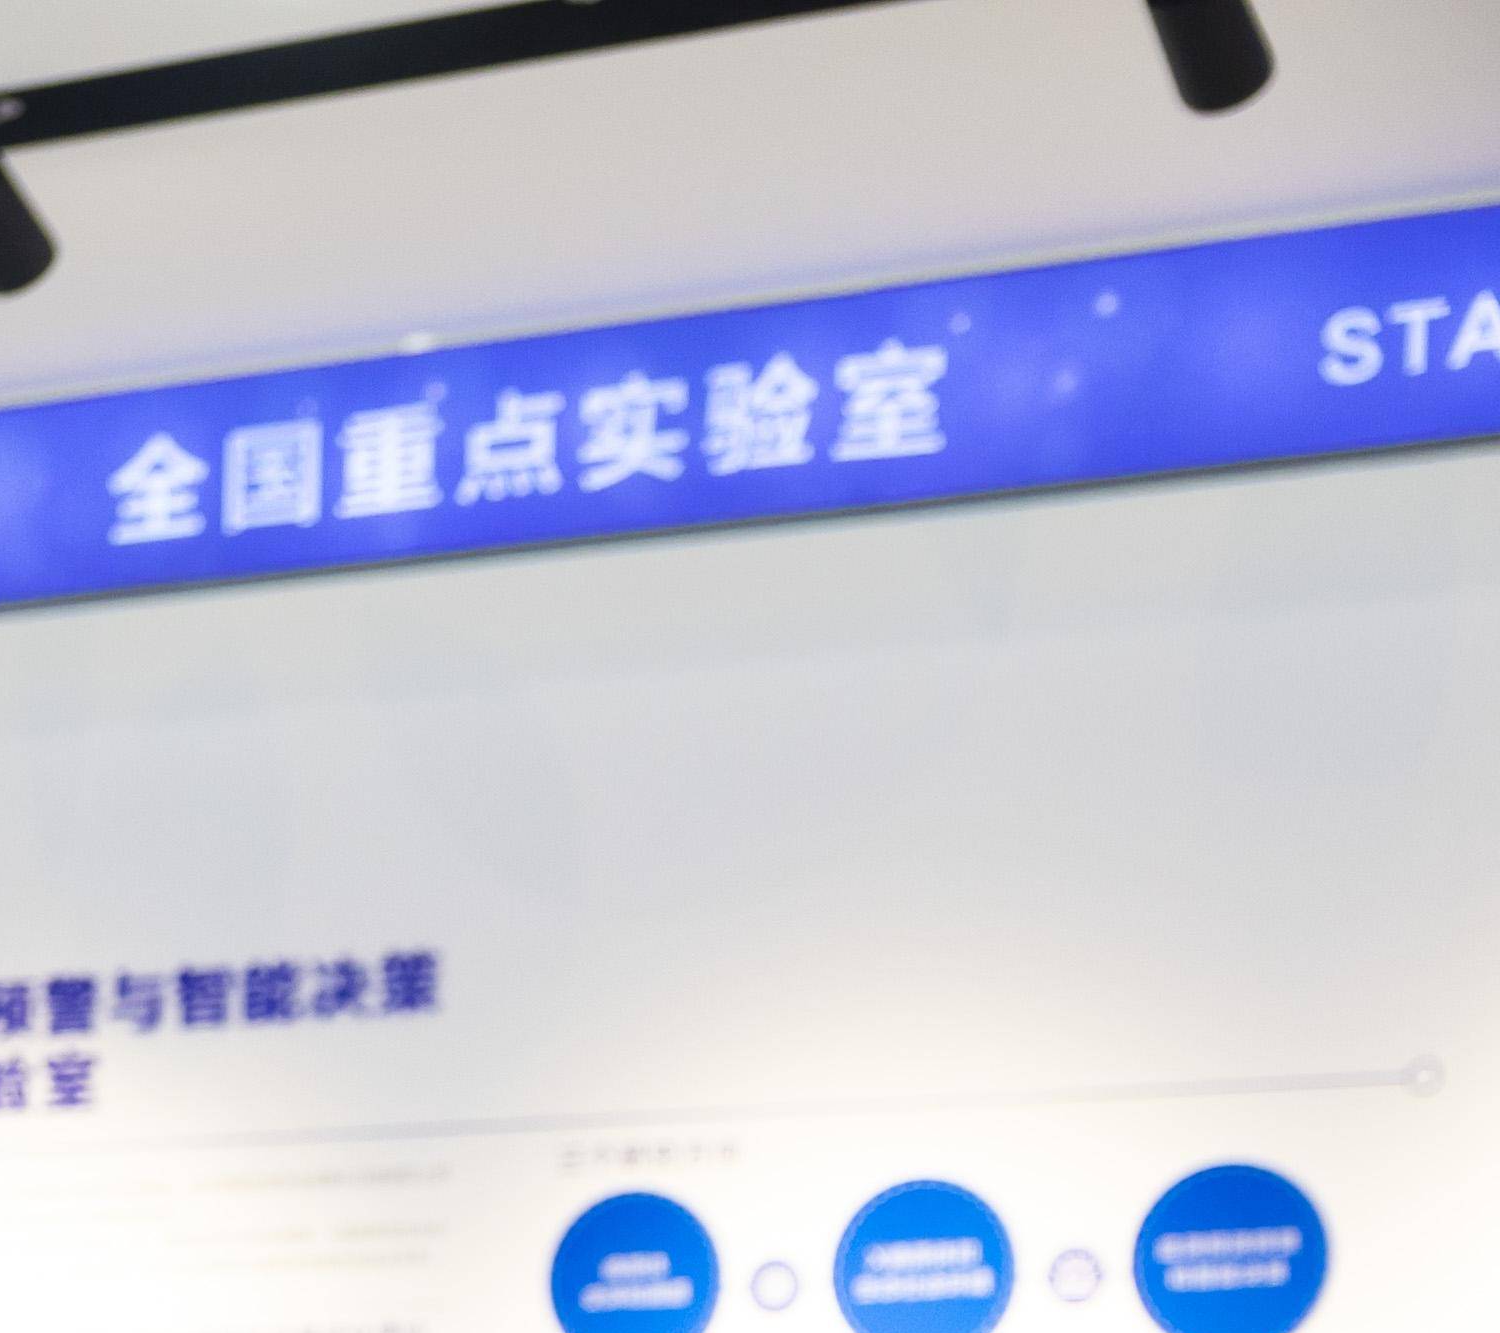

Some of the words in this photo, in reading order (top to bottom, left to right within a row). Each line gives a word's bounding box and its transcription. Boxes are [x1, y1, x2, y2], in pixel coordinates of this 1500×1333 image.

[106, 338, 950, 548] 全国重点实验室
